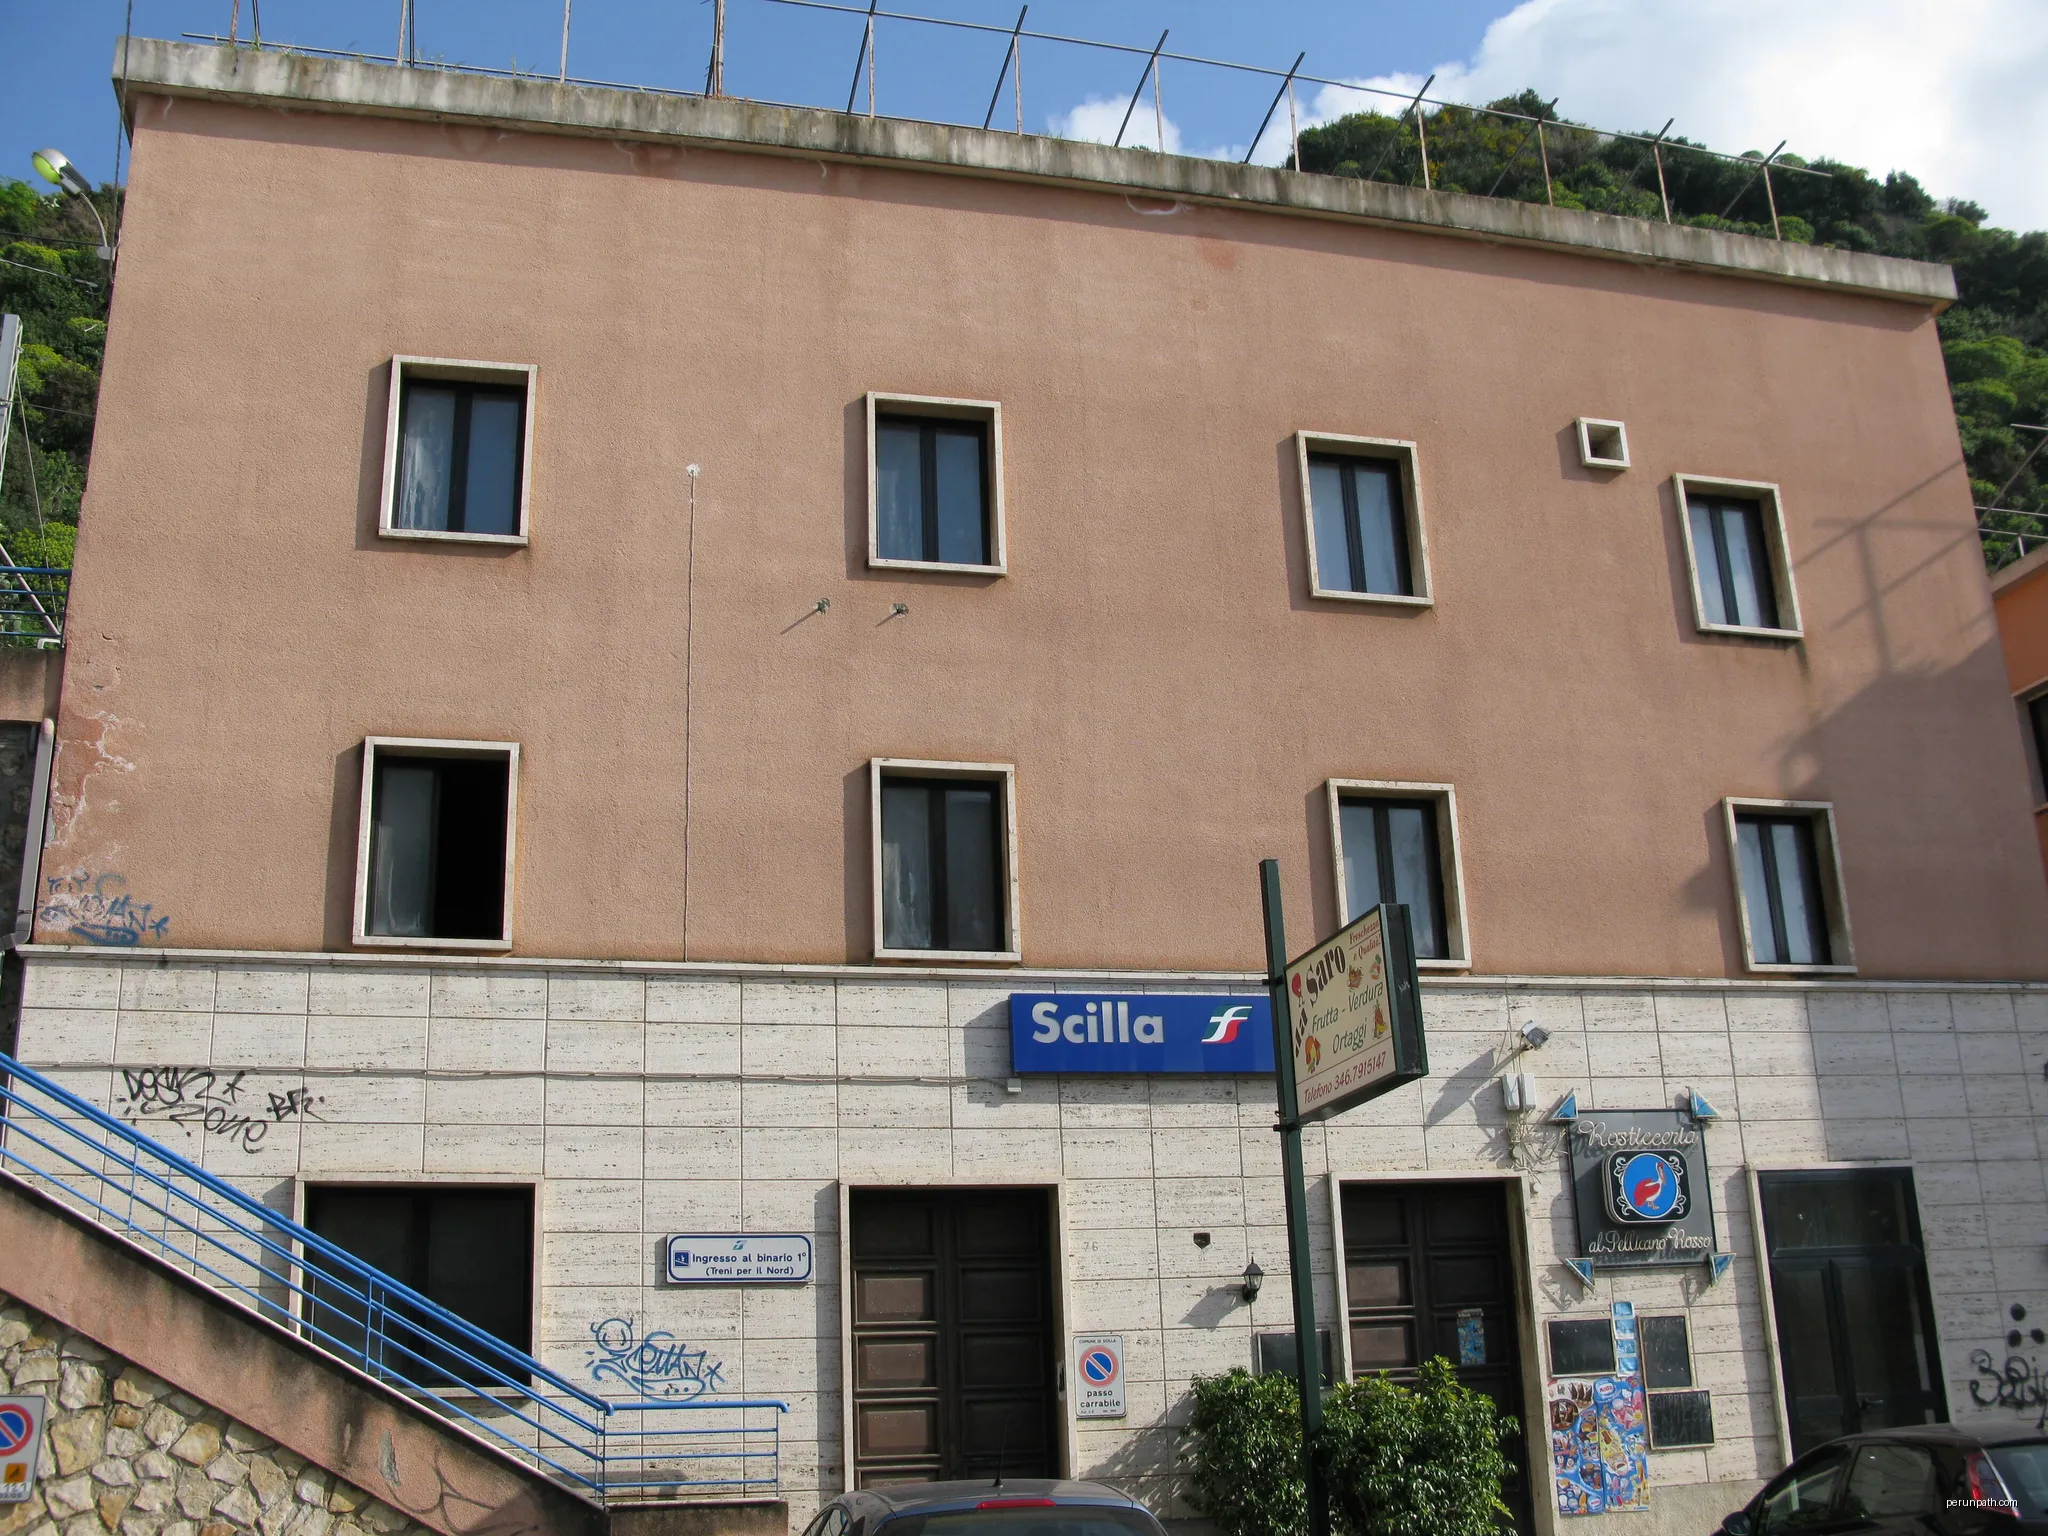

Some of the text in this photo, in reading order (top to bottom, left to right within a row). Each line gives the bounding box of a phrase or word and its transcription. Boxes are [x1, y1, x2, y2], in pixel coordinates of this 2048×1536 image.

[1306, 945, 1346, 1006] Saro
[1032, 1001, 1165, 1044] Scilla
[1312, 1007, 1339, 1034] Frutta
[1348, 981, 1384, 1013] Verdura
[1332, 1017, 1368, 1055] Ortaggi
[1304, 1051, 1387, 1105] Telefono 346.7915147
[1578, 1120, 1699, 1147] Rosticceria
[692, 1254, 737, 1264] Ingresso
[742, 1254, 751, 1262] al
[757, 1253, 793, 1263] binario
[705, 1266, 794, 1276] (Treni per il Nord)
[1080, 1399, 1121, 1408] carrabile
[1086, 1389, 1113, 1398] passo
